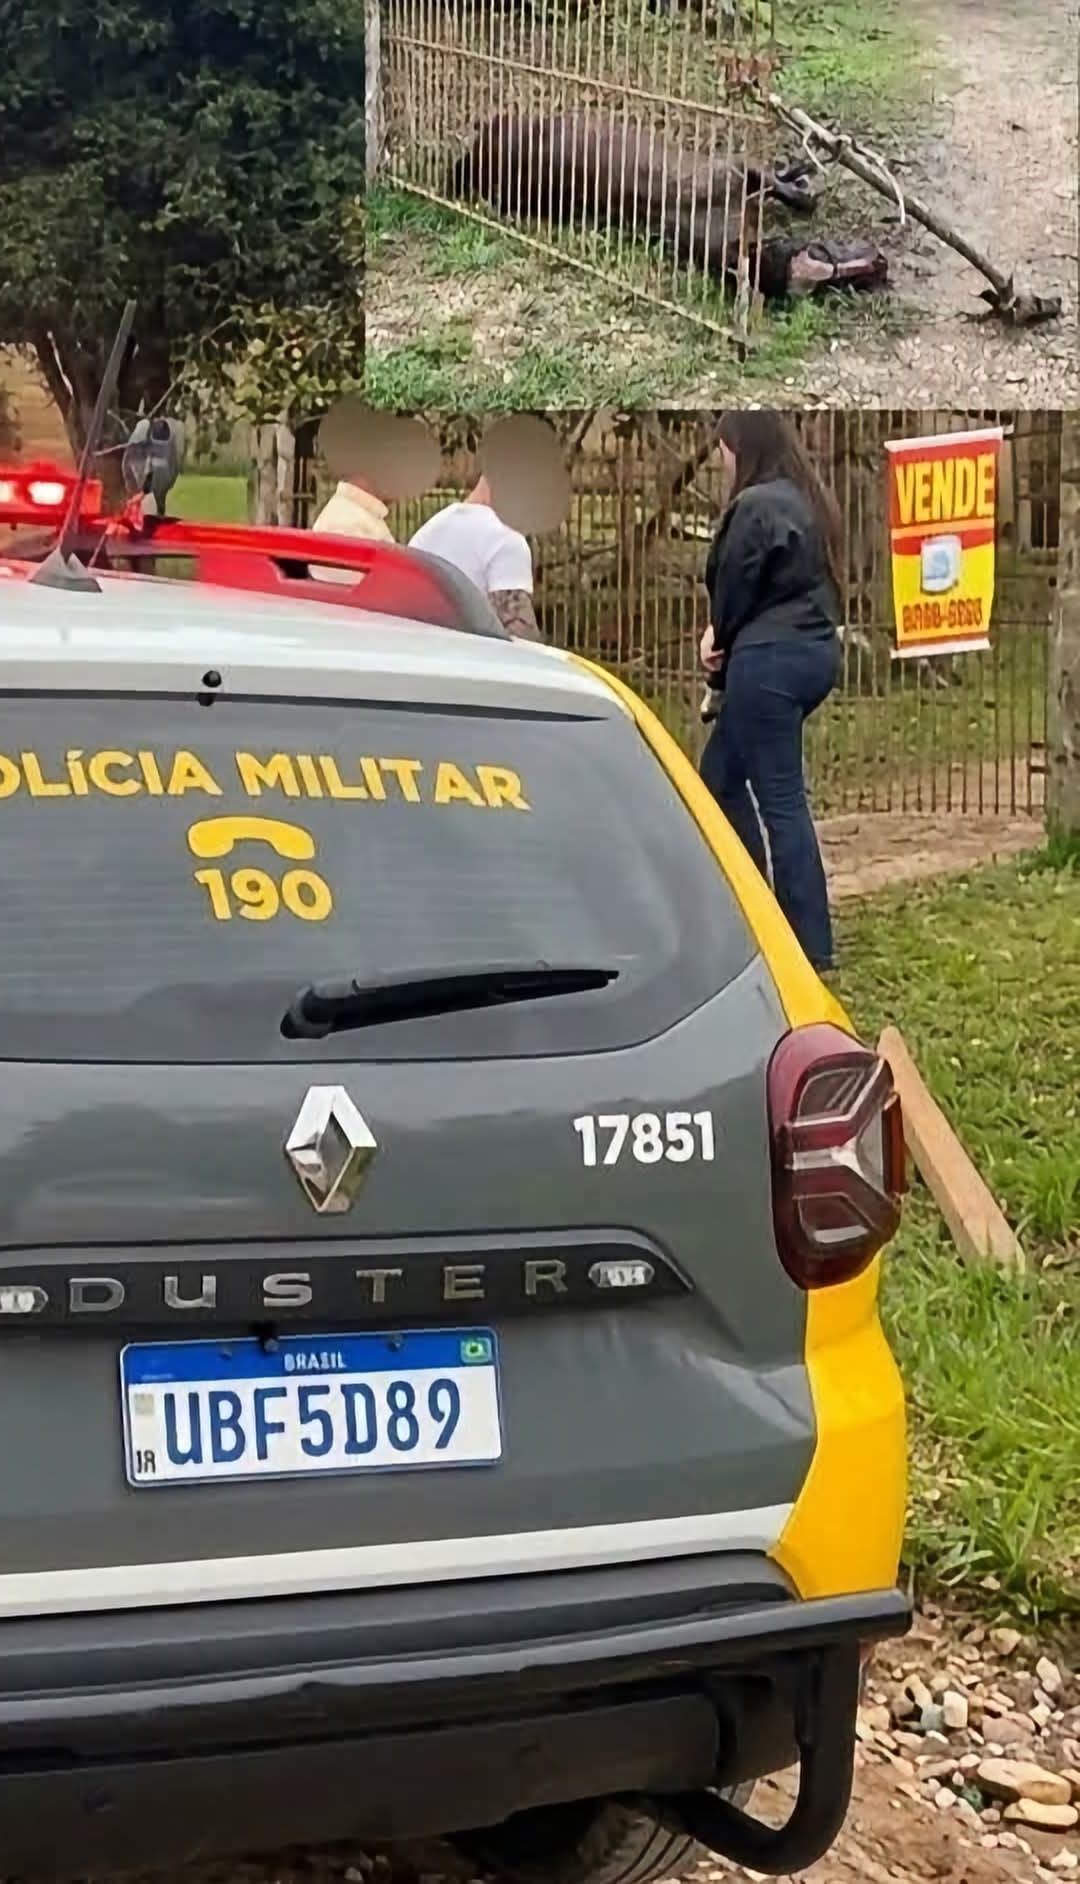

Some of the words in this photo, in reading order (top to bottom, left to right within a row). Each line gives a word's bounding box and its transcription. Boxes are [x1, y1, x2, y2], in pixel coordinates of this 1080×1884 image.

[895, 452, 996, 525] VENDE
[235, 751, 531, 811] MILITAR
[194, 867, 333, 922] 190
[573, 1110, 715, 1166] 17851
[69, 1258, 568, 1313] DUSTER
[283, 1351, 347, 1372] BRASIL
[163, 1378, 461, 1465] UBF5D89
